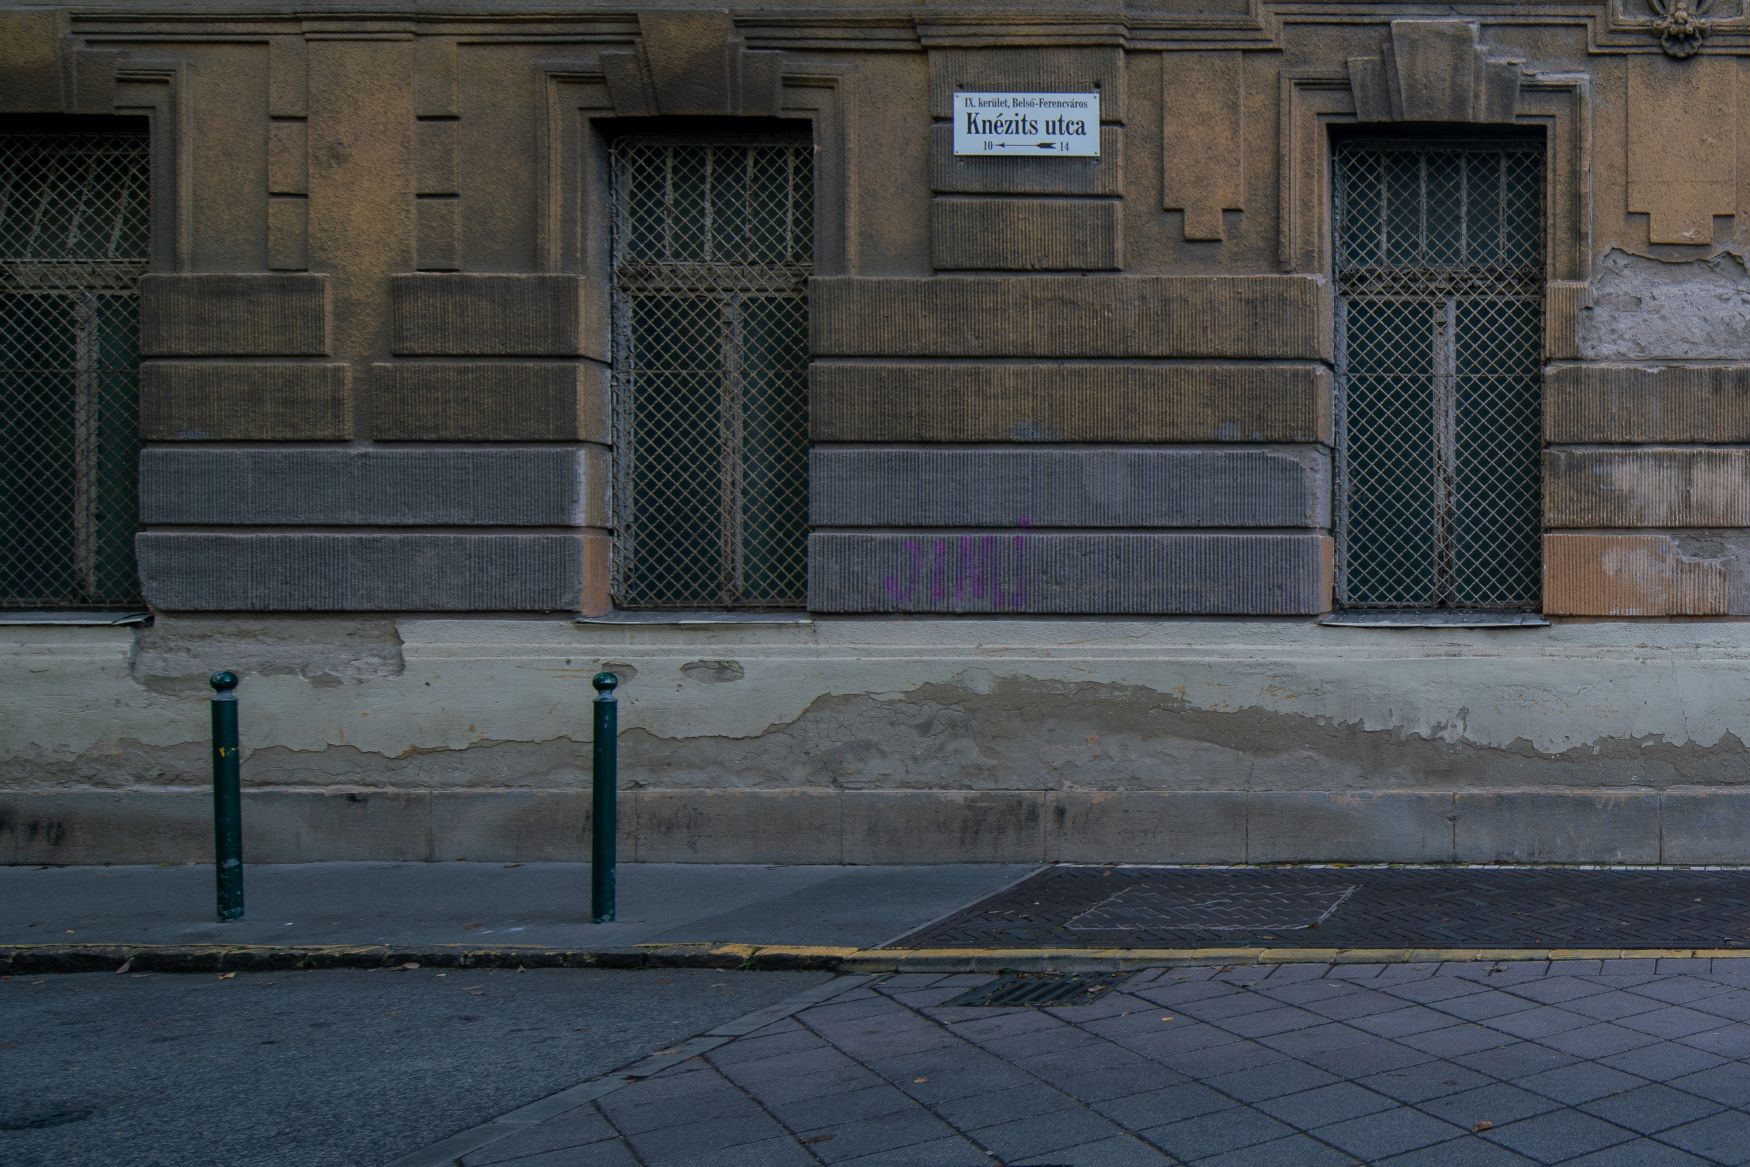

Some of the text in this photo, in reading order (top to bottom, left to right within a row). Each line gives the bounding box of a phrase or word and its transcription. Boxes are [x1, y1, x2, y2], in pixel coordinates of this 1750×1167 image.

[965, 98, 1088, 109] IX. kerület, Belső-Ferencváros
[966, 112, 1087, 136] Knézits utca
[983, 141, 1069, 151] 10 14
